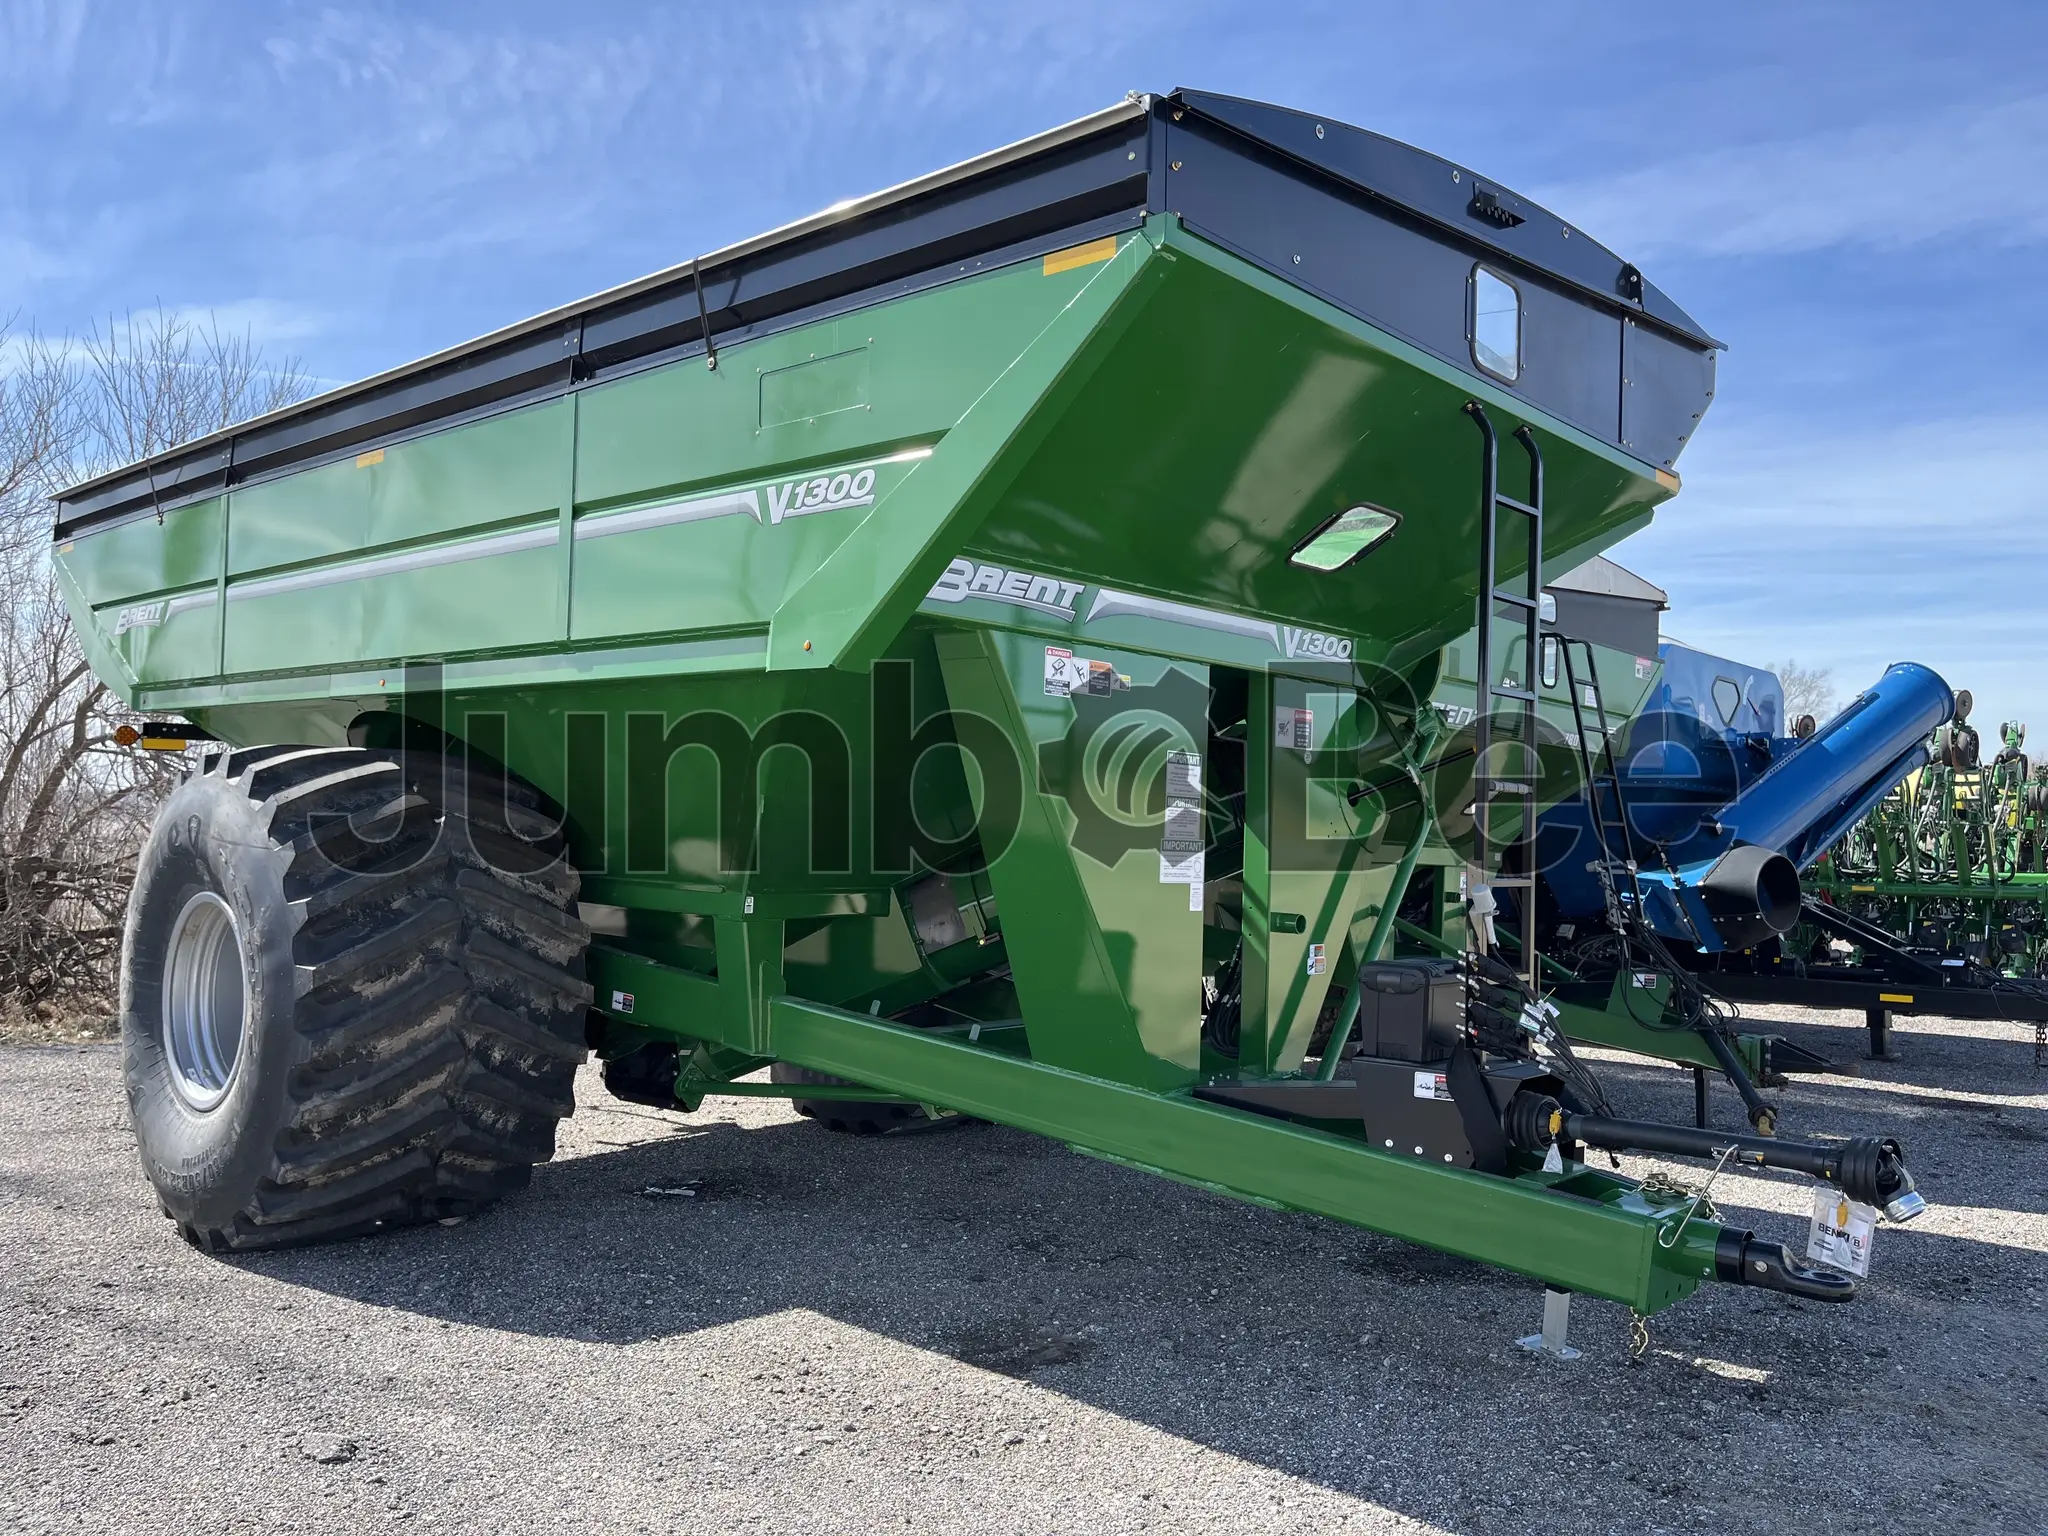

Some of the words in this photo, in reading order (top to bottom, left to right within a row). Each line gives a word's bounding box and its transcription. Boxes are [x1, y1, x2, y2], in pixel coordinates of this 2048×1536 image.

[767, 469, 875, 525] V1300
[926, 558, 1086, 609] BRENT
[114, 602, 165, 635] BRENT
[1284, 626, 1351, 659] V1300
[1163, 840, 1203, 852] IMPORTANT
[1818, 1222, 1850, 1243] BENI
